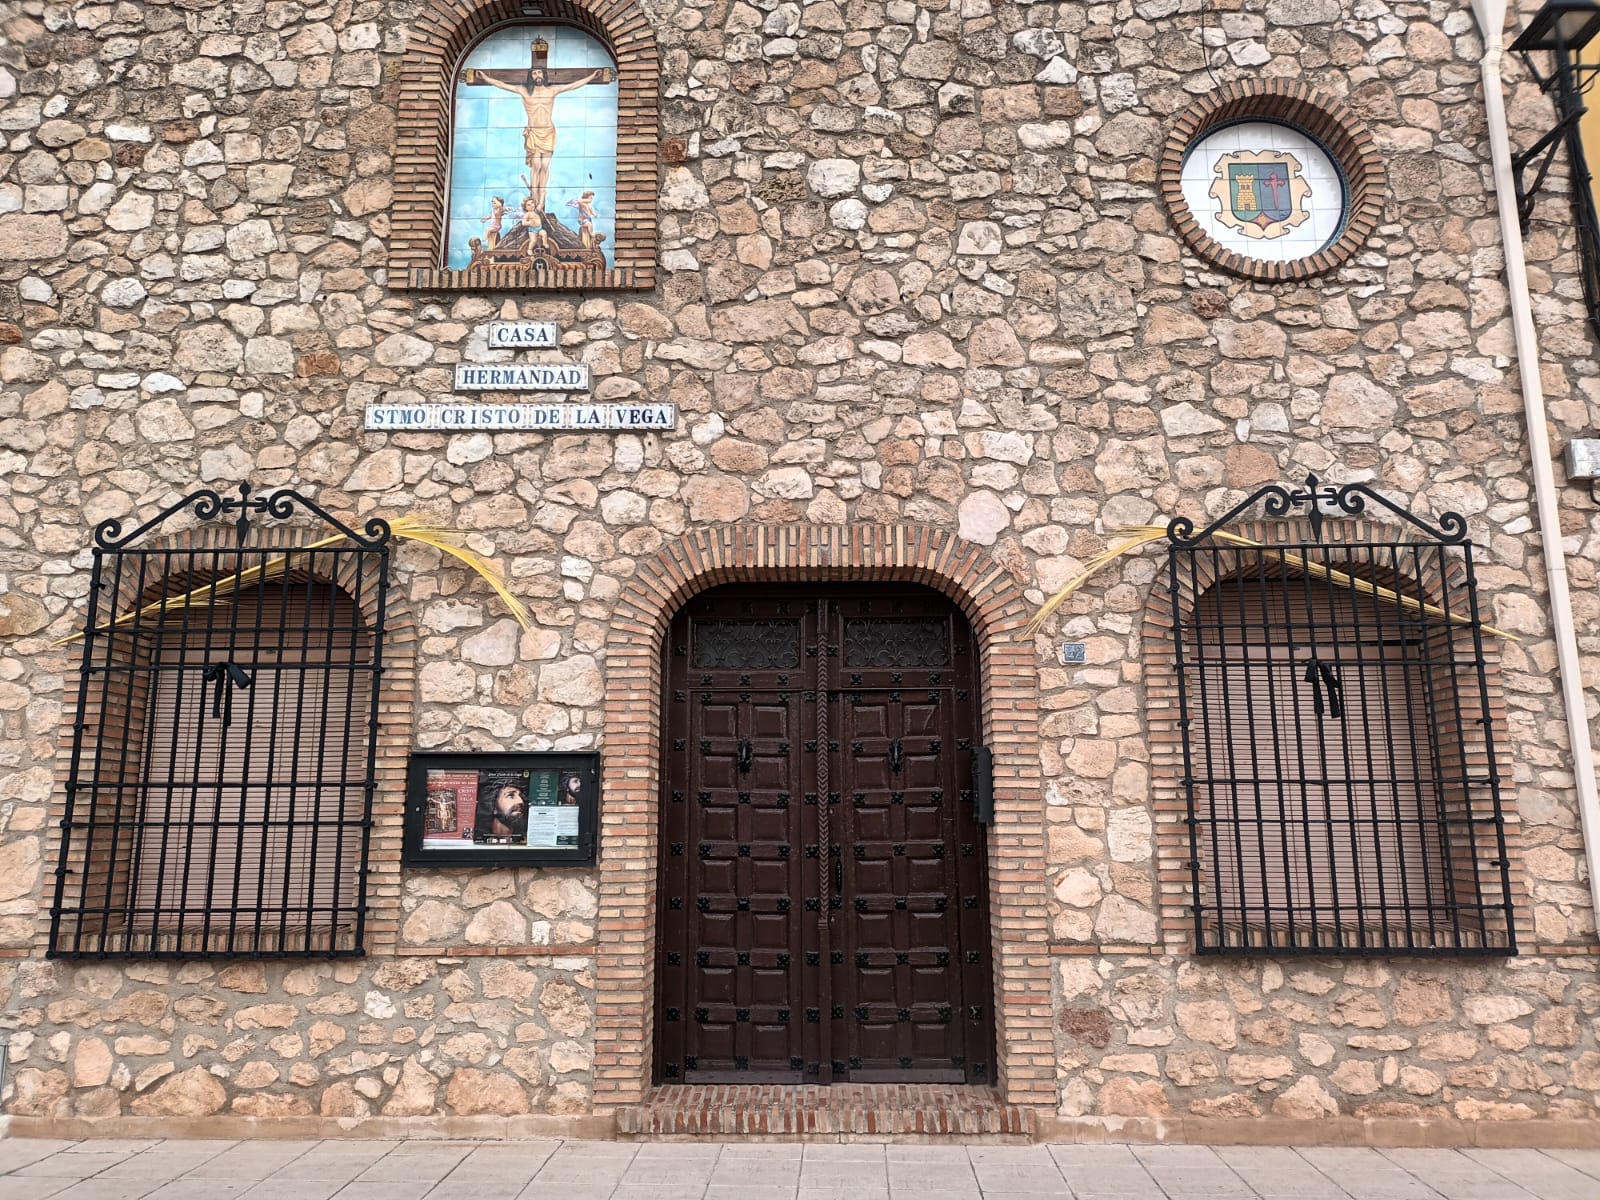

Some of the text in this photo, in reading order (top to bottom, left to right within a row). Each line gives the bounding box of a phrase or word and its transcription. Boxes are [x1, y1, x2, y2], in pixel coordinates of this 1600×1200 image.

[497, 327, 549, 342] CASA
[463, 369, 581, 385] HERMANDAD
[373, 408, 667, 425] STMO CRISTO DE LA VEGA
